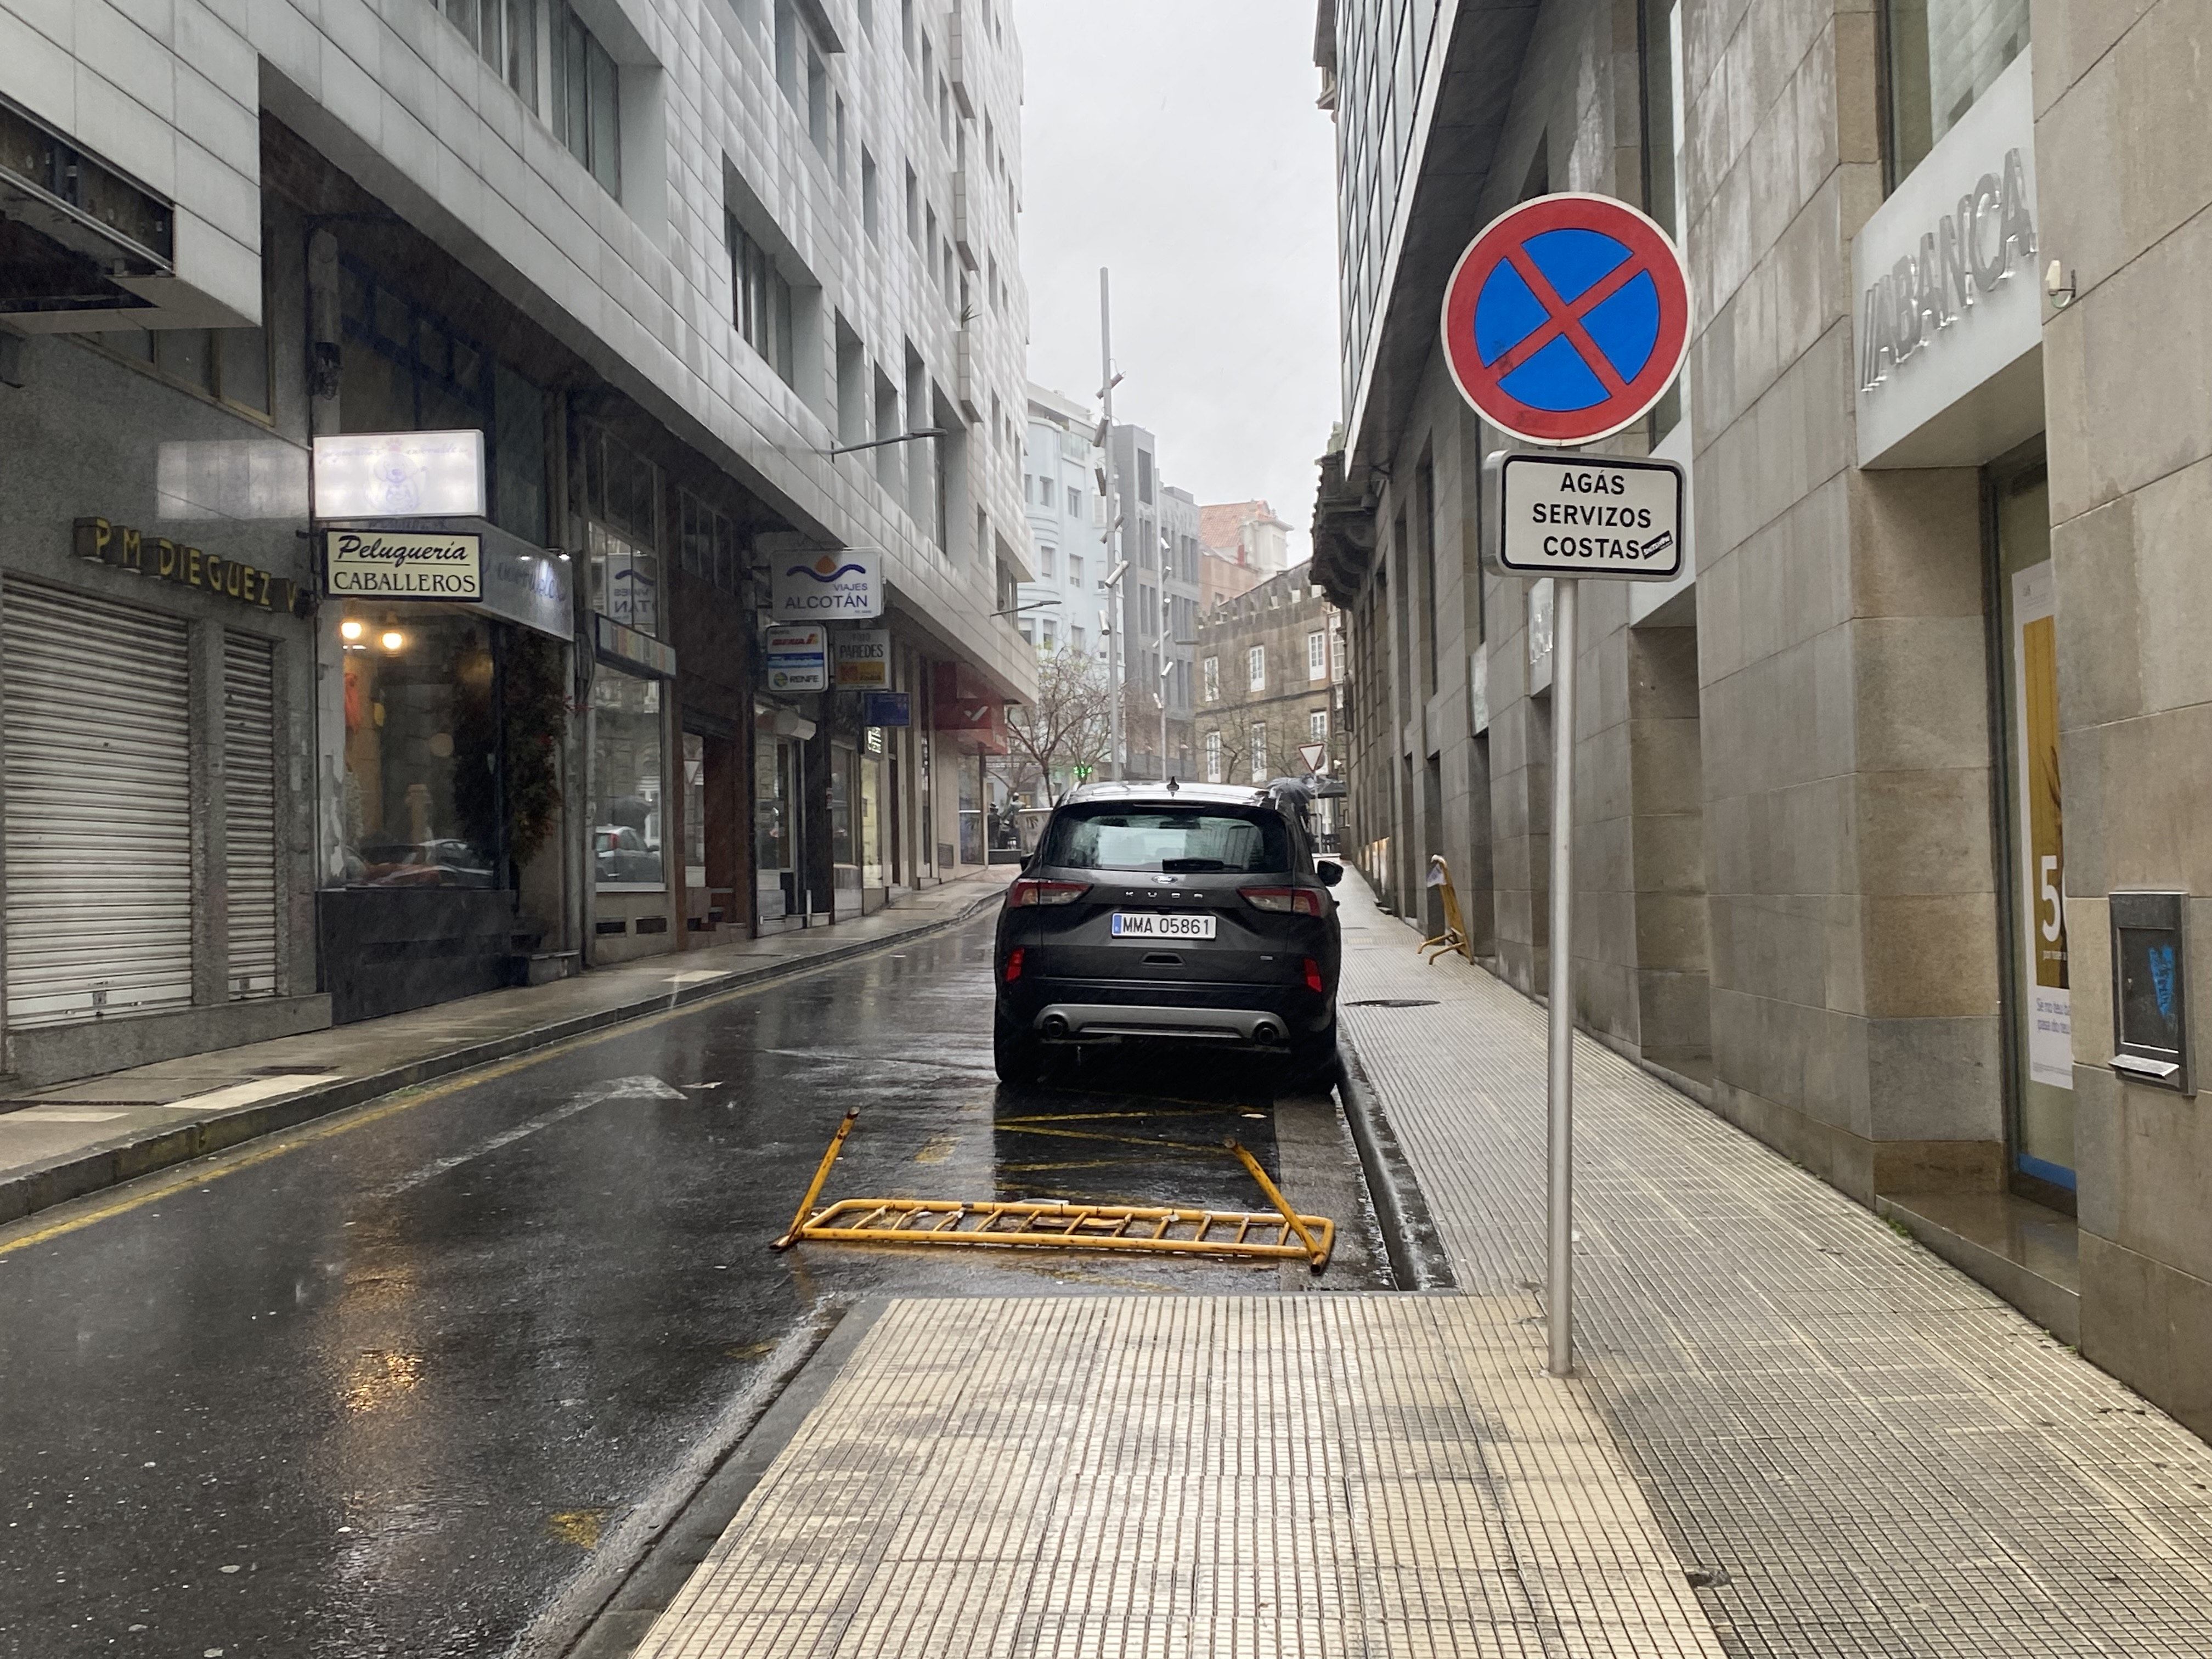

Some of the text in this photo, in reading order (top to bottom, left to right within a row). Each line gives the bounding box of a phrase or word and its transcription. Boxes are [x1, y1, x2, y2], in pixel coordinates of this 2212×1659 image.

[1861, 147, 2038, 391] ABANCA
[1560, 470, 1625, 495] AGÁS
[1532, 503, 1651, 528] SERVIZOS
[338, 535, 467, 567] Peluquería
[1543, 535, 1640, 560] COSTAS
[334, 572, 476, 592] CABALLEROS
[833, 583, 868, 591] VIAJES
[785, 592, 867, 609] ALCOTÁN
[839, 644, 884, 658] PAREDES
[1122, 917, 1209, 935] MMA 05861
